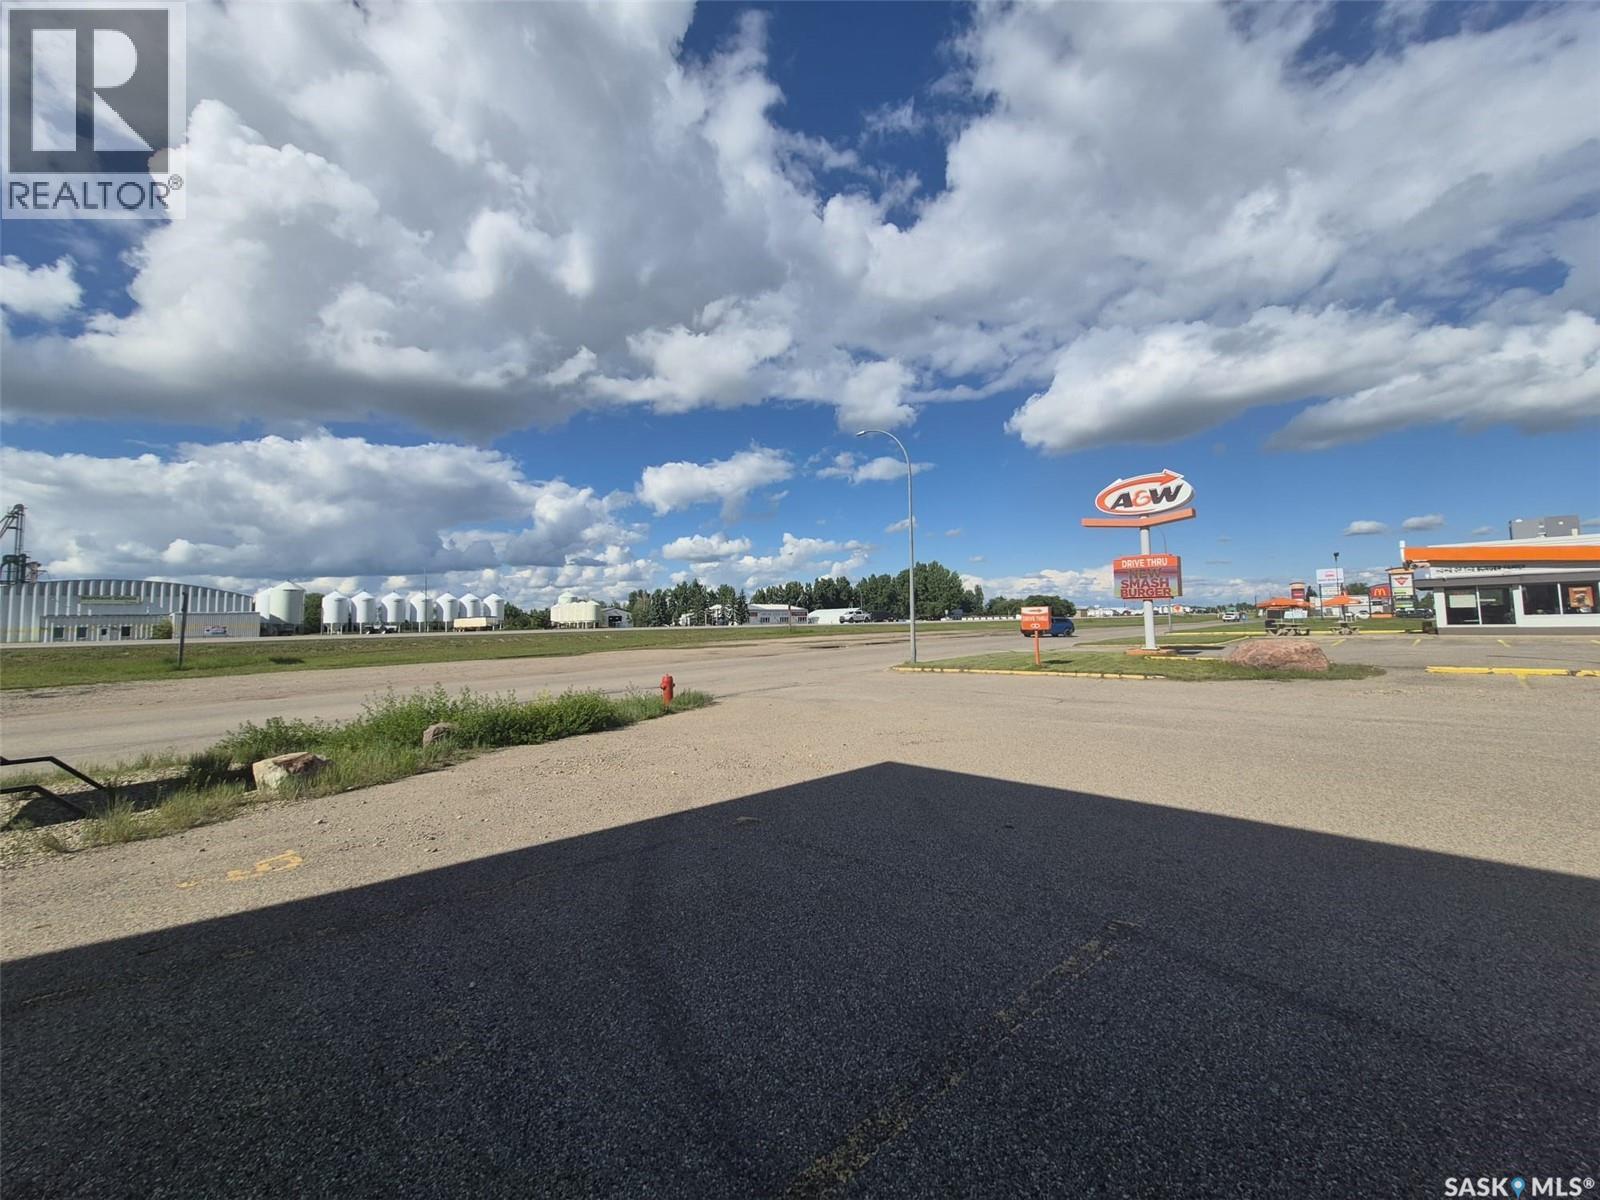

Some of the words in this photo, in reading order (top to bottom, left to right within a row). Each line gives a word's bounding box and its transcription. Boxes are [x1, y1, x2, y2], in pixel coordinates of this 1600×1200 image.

[1110, 484, 1184, 510] A&W
[1121, 558, 1144, 568] DRIVE
[1146, 557, 1168, 567] THRU
[1128, 568, 1161, 579] NEW
[1121, 578, 1170, 589] SMASH
[1121, 587, 1172, 598] BURGER
